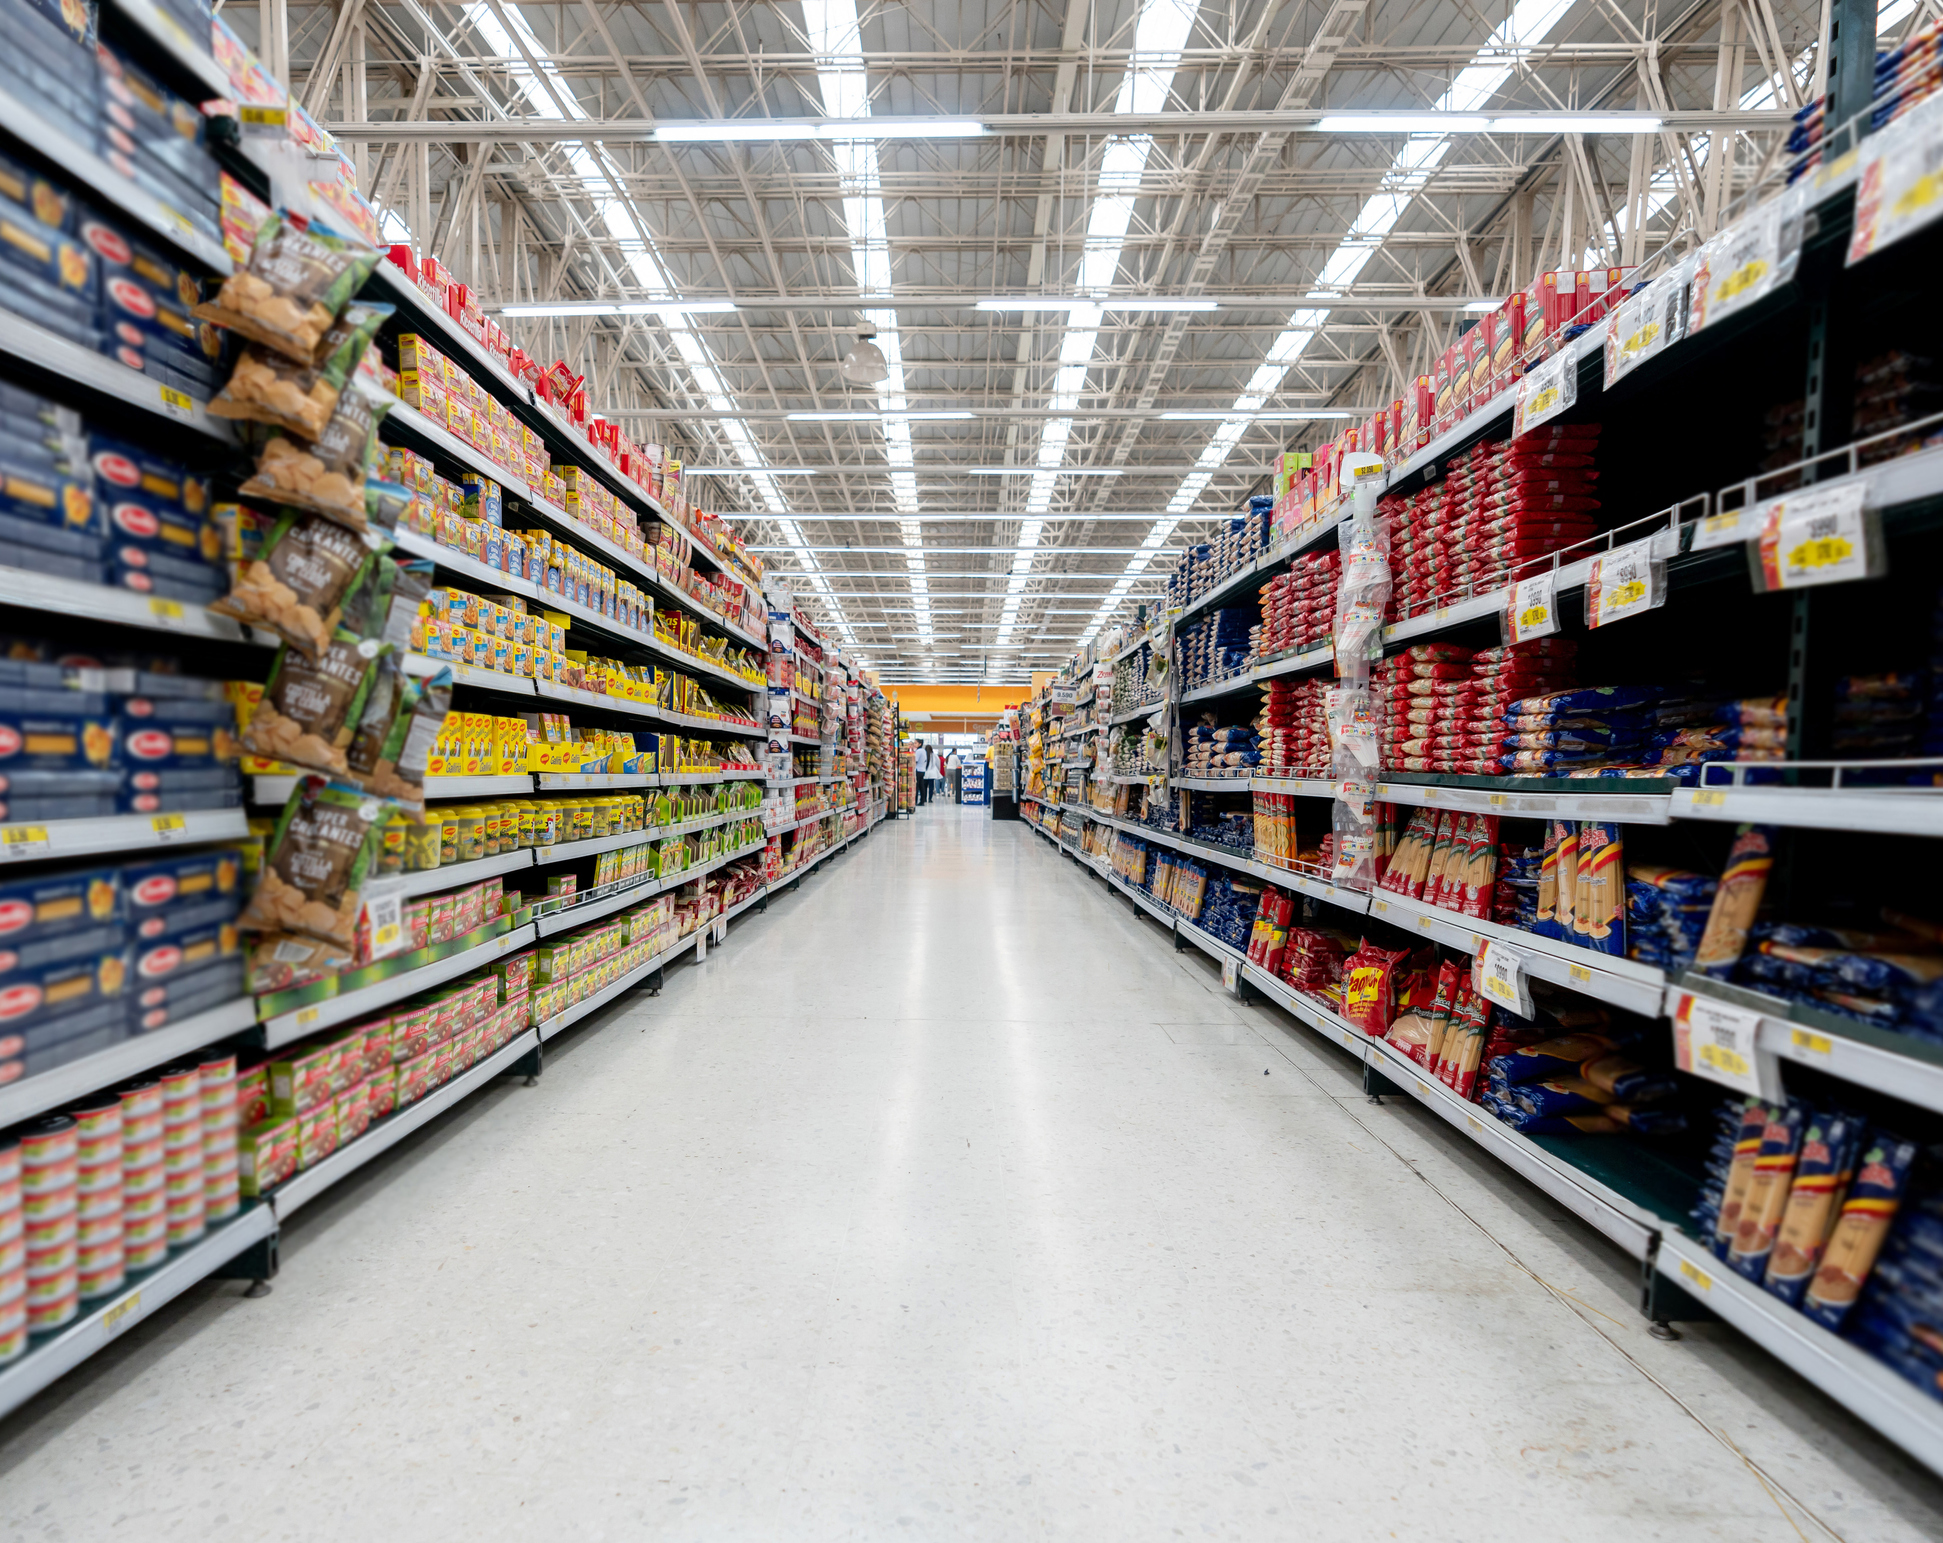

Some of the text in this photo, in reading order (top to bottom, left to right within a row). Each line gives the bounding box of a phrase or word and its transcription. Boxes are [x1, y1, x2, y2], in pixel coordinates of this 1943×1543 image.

[445, 762, 461, 774] Gallina
[1583, 827, 1592, 838] Sa
[1592, 829, 1605, 838] San
